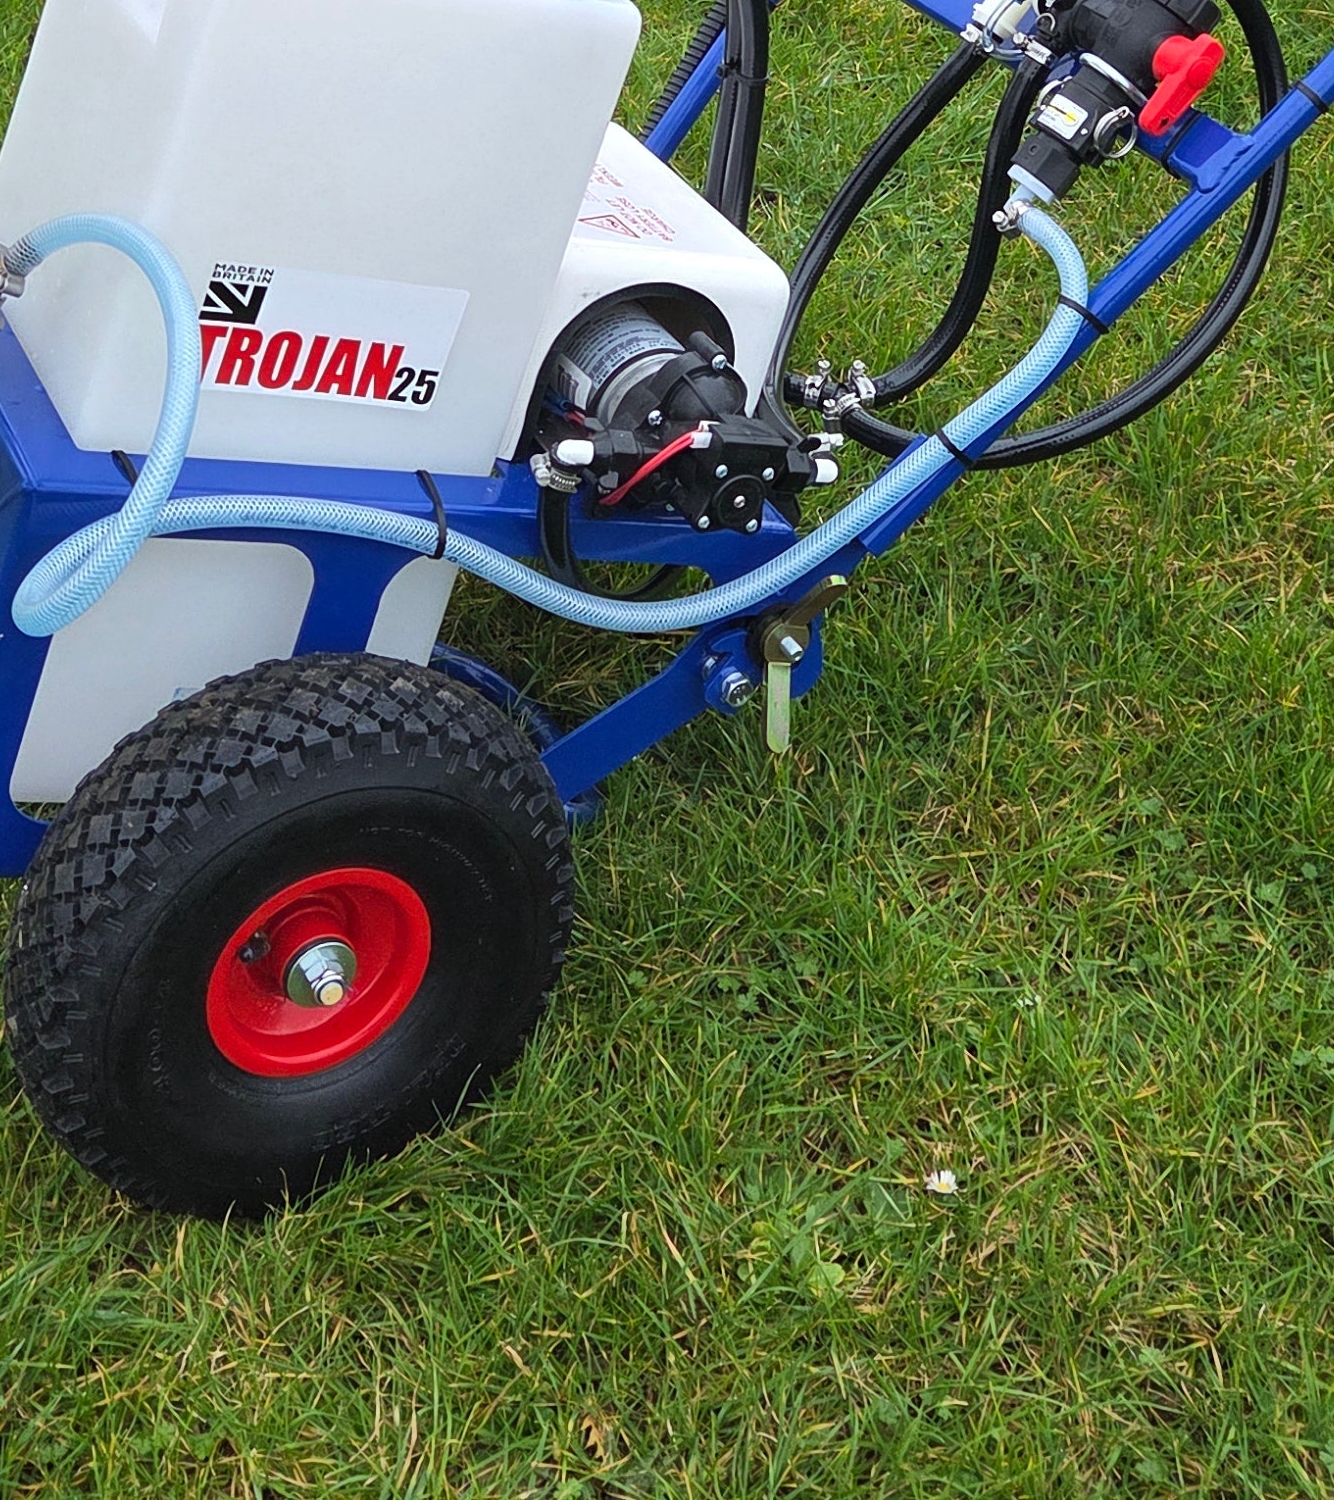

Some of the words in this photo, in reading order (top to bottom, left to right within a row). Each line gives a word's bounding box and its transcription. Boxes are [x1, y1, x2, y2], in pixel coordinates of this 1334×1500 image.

[214, 262, 258, 275] MADE
[260, 267, 275, 277] IN
[211, 270, 273, 285] BRITAIN
